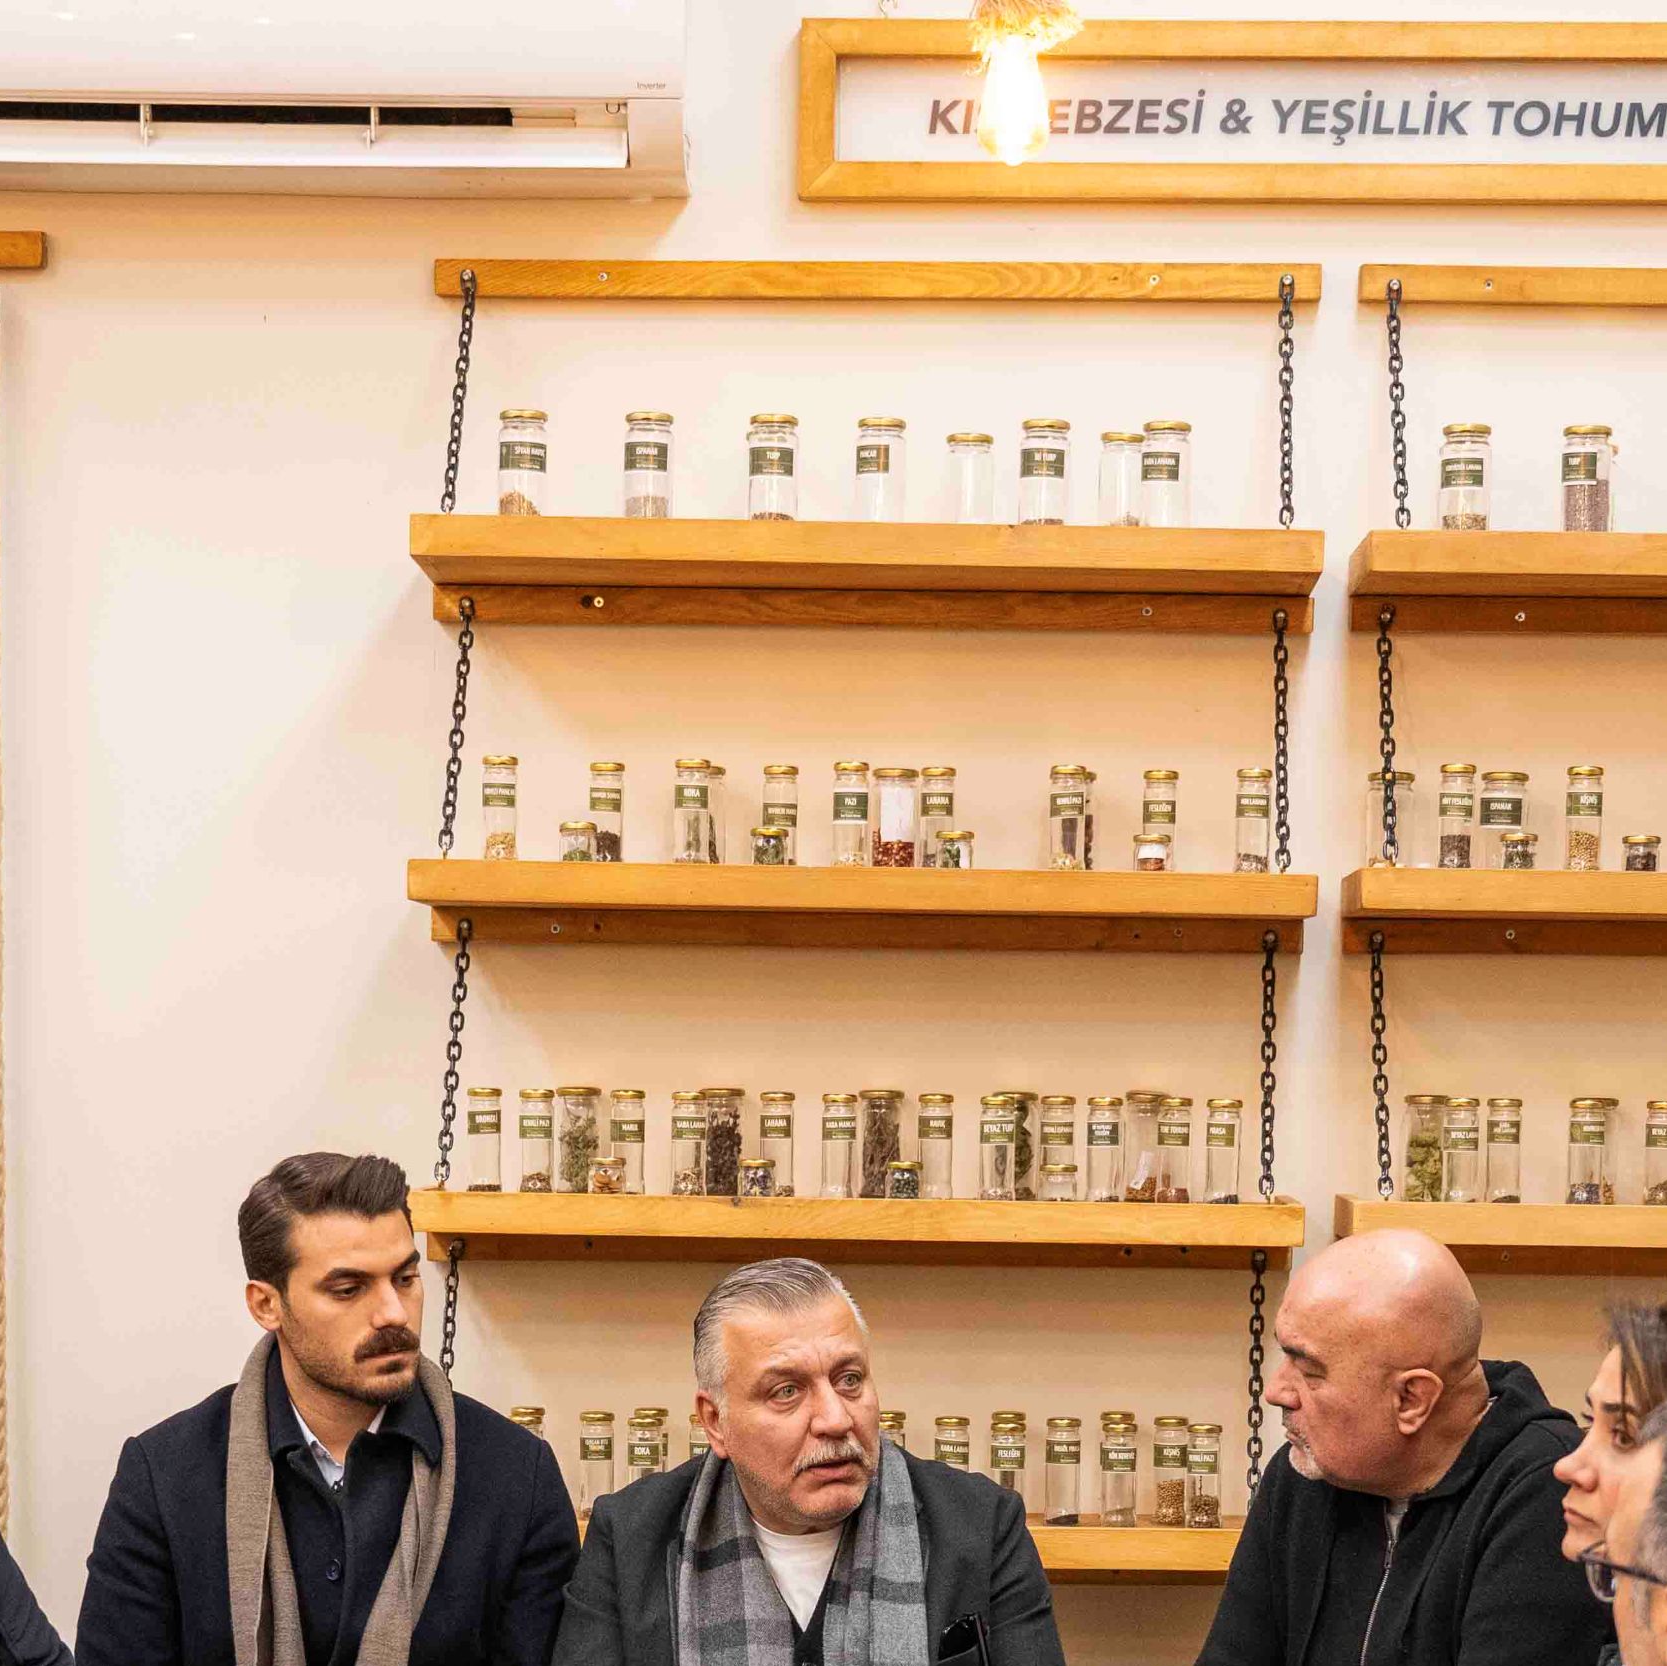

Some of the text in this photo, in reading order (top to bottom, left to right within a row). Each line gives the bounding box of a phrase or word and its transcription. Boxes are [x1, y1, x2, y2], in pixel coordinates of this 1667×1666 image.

[636, 81, 666, 89] Inverter
[928, 99, 984, 135] KI
[1026, 89, 1207, 135] EBZESİ
[1219, 98, 1253, 135] &
[1272, 89, 1471, 147] YEŞİLLİK
[683, 788, 700, 797] ROKA
[844, 797, 857, 806] PAZI
[764, 1119, 787, 1128] LAHANA
[634, 1446, 651, 1456] ROKA
